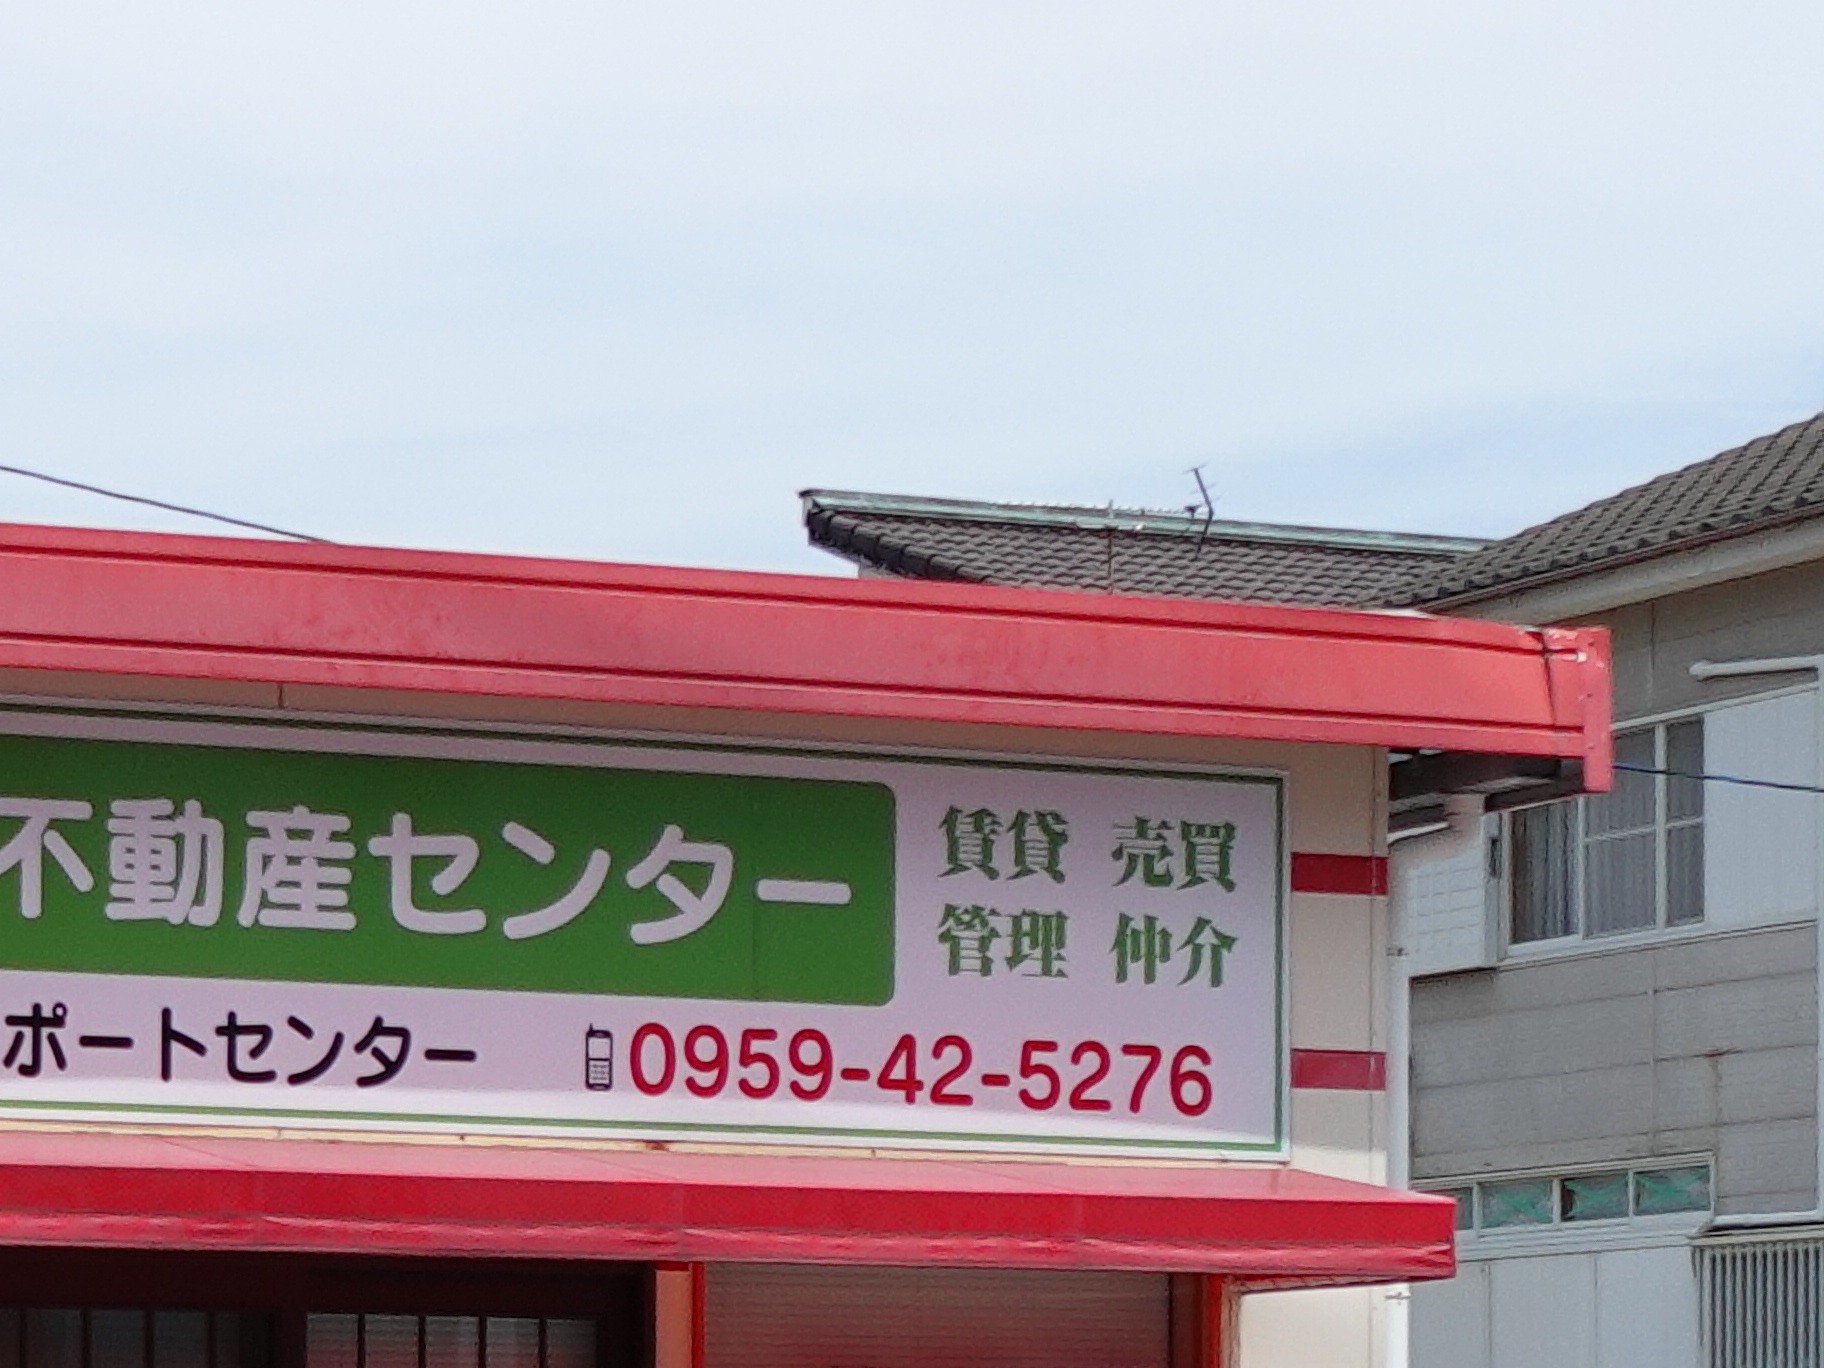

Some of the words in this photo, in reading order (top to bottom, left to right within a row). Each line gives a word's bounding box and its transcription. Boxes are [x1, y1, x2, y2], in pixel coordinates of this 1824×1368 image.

[938, 804, 1070, 884] 賃貸
[1111, 815, 1237, 893] 売買
[937, 902, 1069, 978] 管理
[1110, 912, 1239, 988] 仲介
[629, 1022, 1213, 1117] 0959-42-5276
